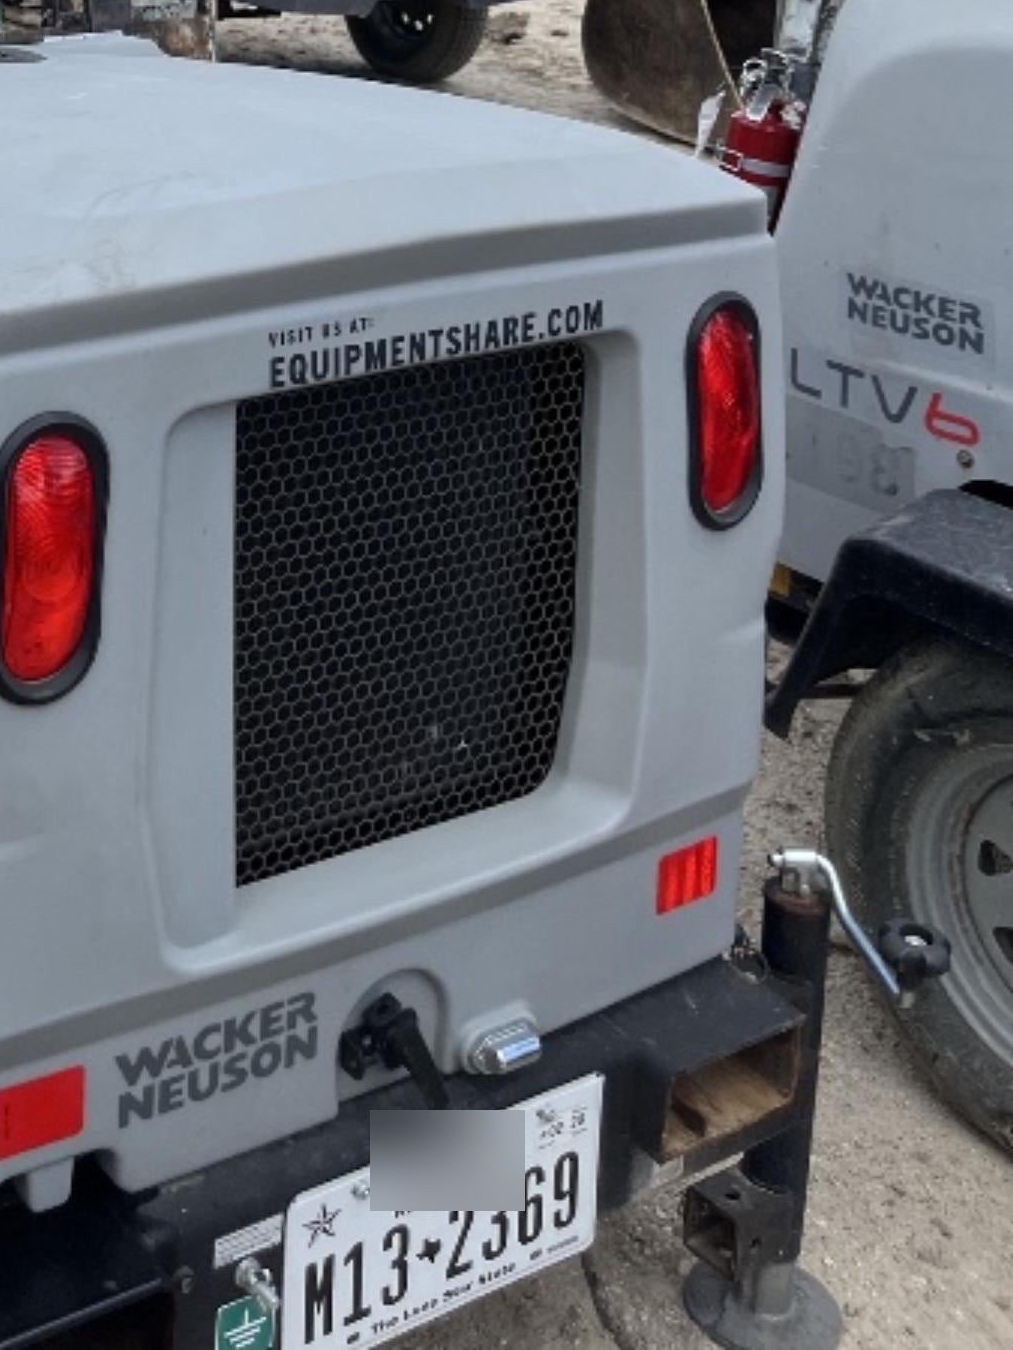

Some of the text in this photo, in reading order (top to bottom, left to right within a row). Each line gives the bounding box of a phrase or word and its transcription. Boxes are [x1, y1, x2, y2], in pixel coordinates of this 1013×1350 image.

[268, 326, 313, 348] VISIT
[322, 321, 342, 338] US
[847, 272, 983, 330] WACKER
[847, 297, 984, 355] NEUSON
[270, 299, 604, 389] EQUIPMENTSHARE.COM
[115, 992, 318, 1087] WACKER
[118, 1025, 318, 1129] NEUSON
